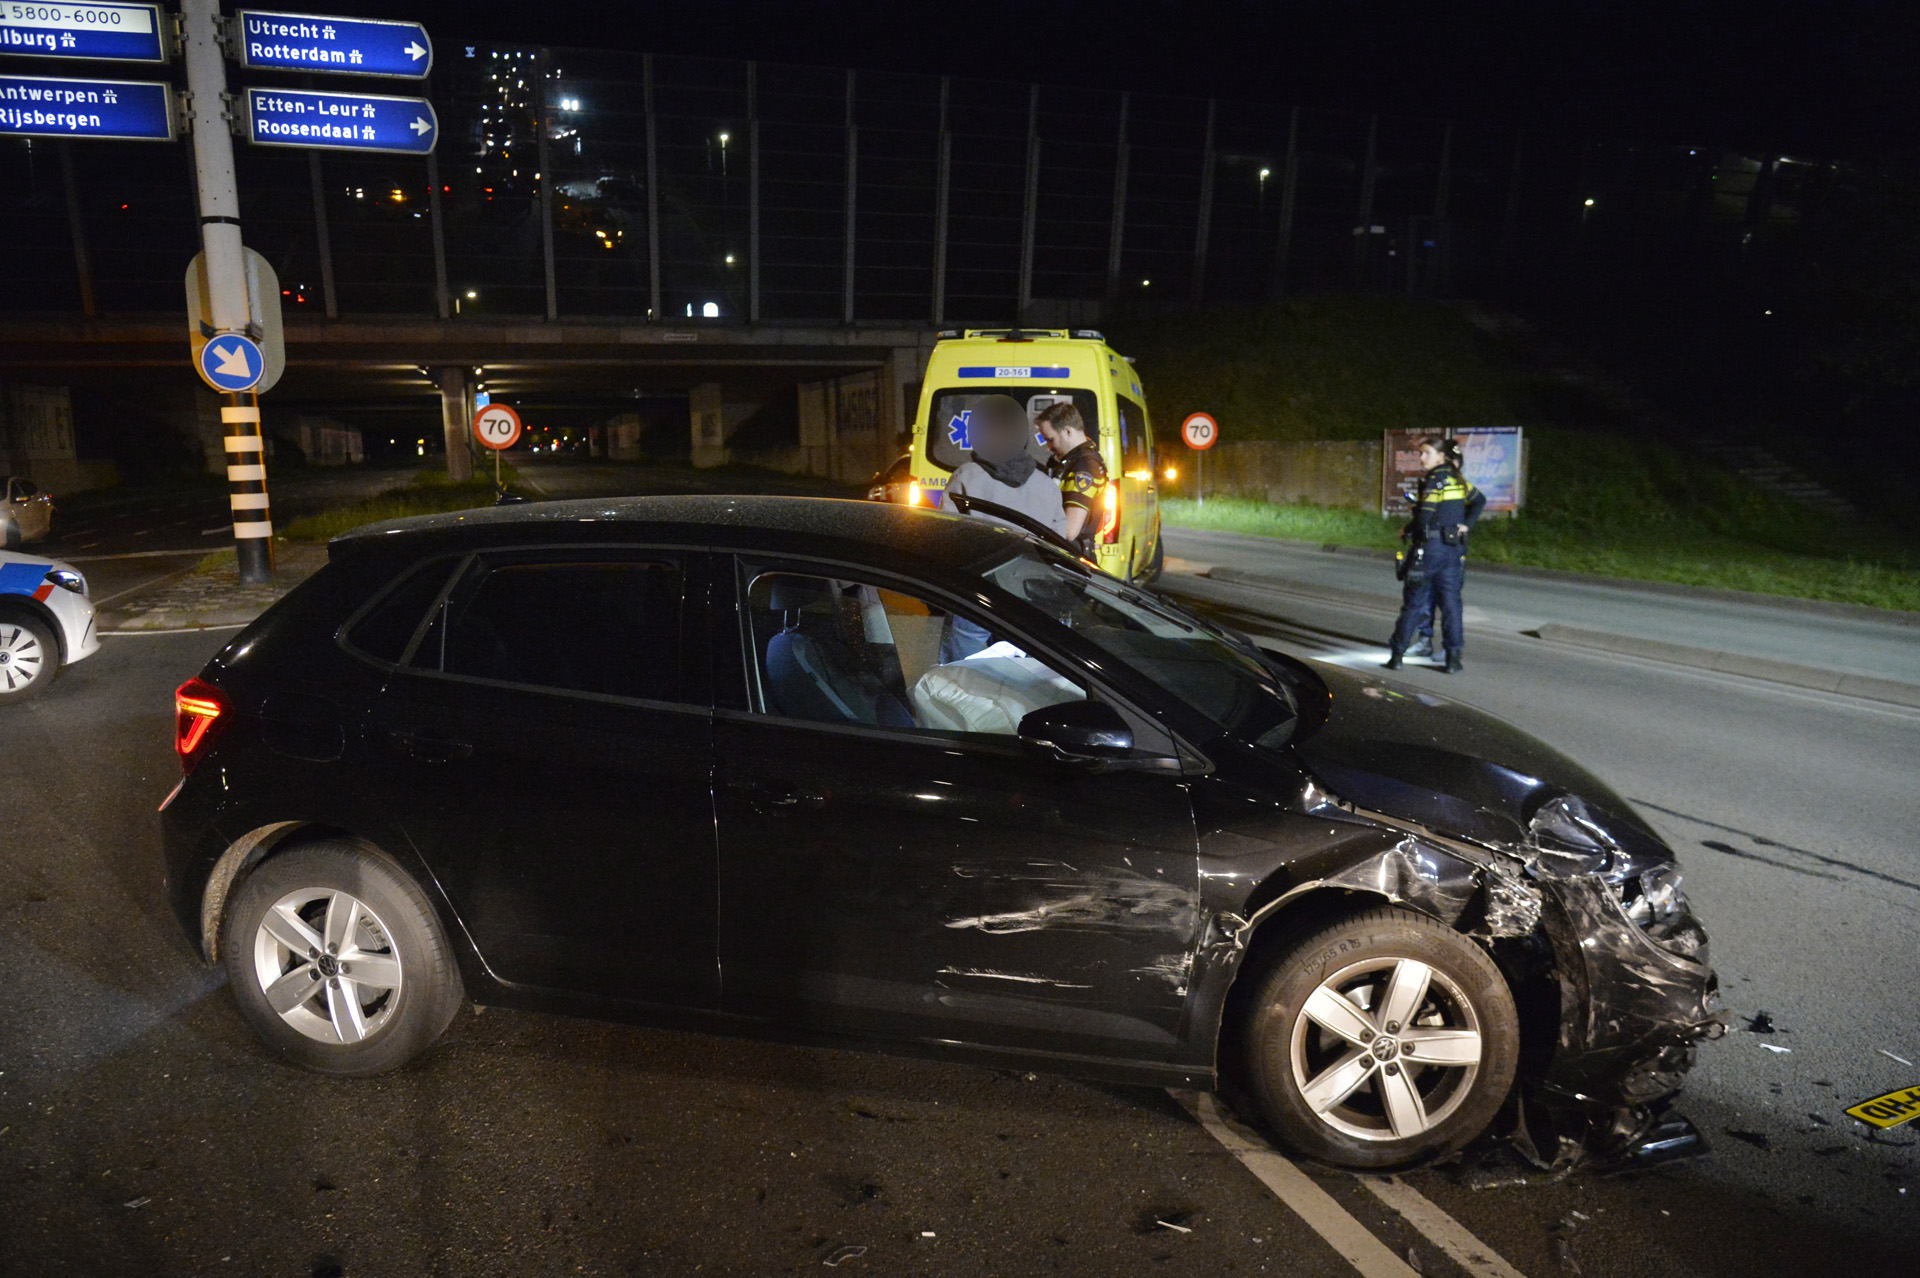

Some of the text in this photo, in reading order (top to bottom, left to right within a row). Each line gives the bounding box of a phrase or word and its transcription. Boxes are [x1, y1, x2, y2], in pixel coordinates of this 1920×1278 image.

[12, 5, 121, 25] 5800-6000
[249, 19, 319, 39] Utrecht
[0, 28, 57, 51] lburg
[251, 42, 346, 63] Rotterdam
[256, 96, 359, 117] Etten-Leur
[0, 108, 101, 130] Rijsbergen
[258, 119, 359, 140] Roosendaal
[998, 368, 1028, 376] 20-161
[483, 418, 512, 435] 70
[1189, 425, 1210, 438] 70
[920, 477, 947, 487] AMB
